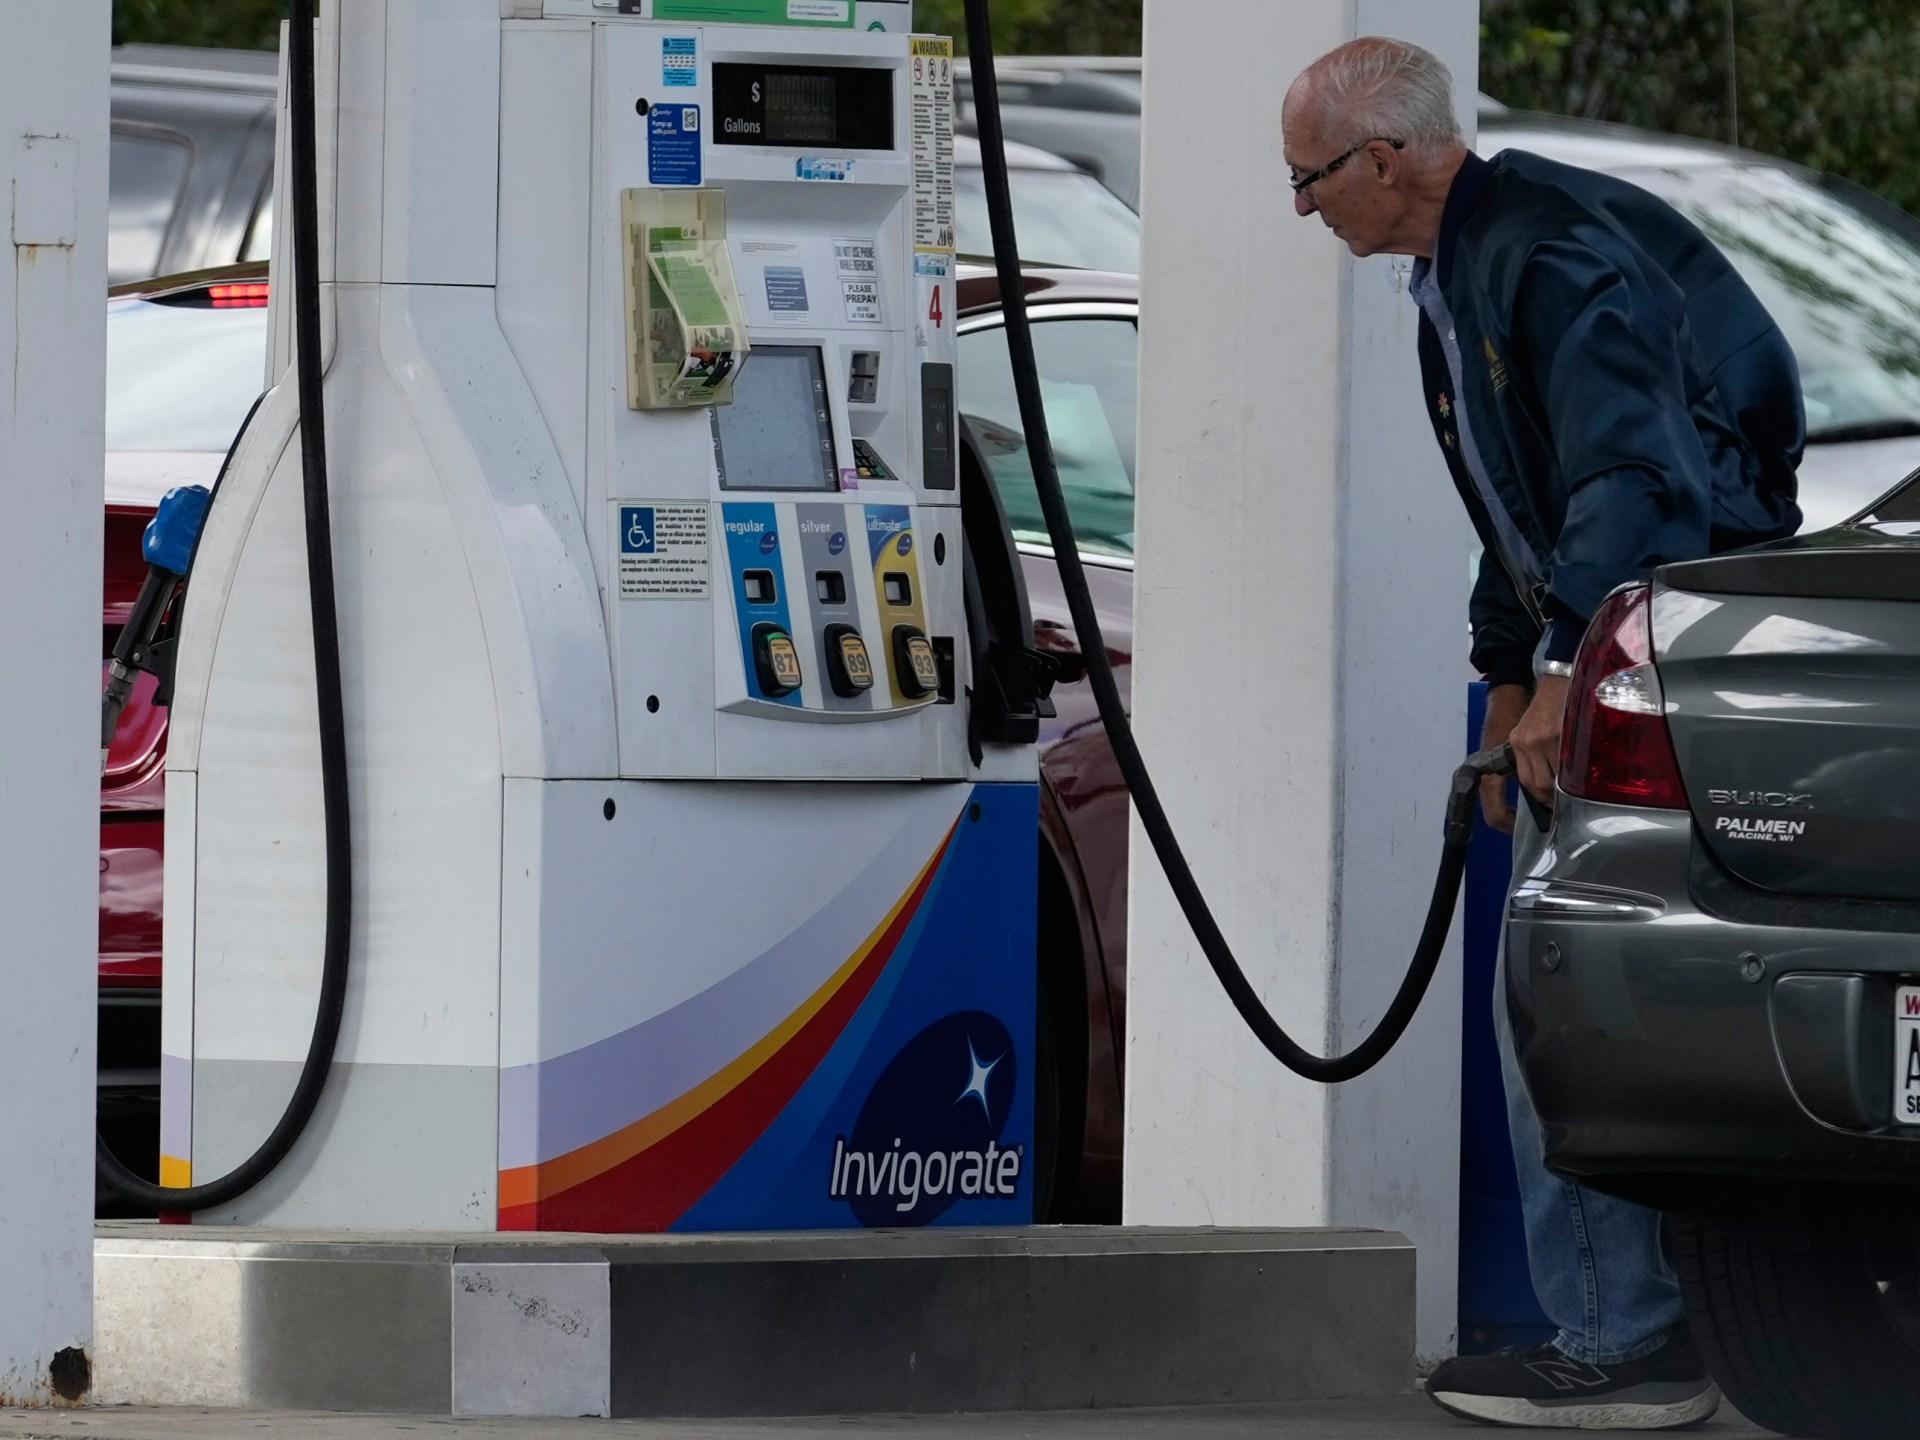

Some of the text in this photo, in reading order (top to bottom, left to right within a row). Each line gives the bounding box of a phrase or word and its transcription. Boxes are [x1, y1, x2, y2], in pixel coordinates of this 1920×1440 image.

[751, 81, 761, 104] $
[724, 117, 761, 134] Gallons
[847, 284, 872, 293] PLEASE
[845, 294, 877, 304] PREPAY
[929, 284, 943, 329] 4
[725, 519, 765, 535] regular
[800, 519, 831, 533] silver
[867, 518, 901, 532] ultimate
[774, 653, 794, 673] 87
[846, 654, 868, 674] 89
[914, 654, 934, 675] 93
[1708, 789, 1815, 810] BUICK
[1715, 816, 1806, 835] PALMEN
[1728, 831, 1795, 842] RACINE, WI
[831, 1137, 1020, 1211] Invigorate
